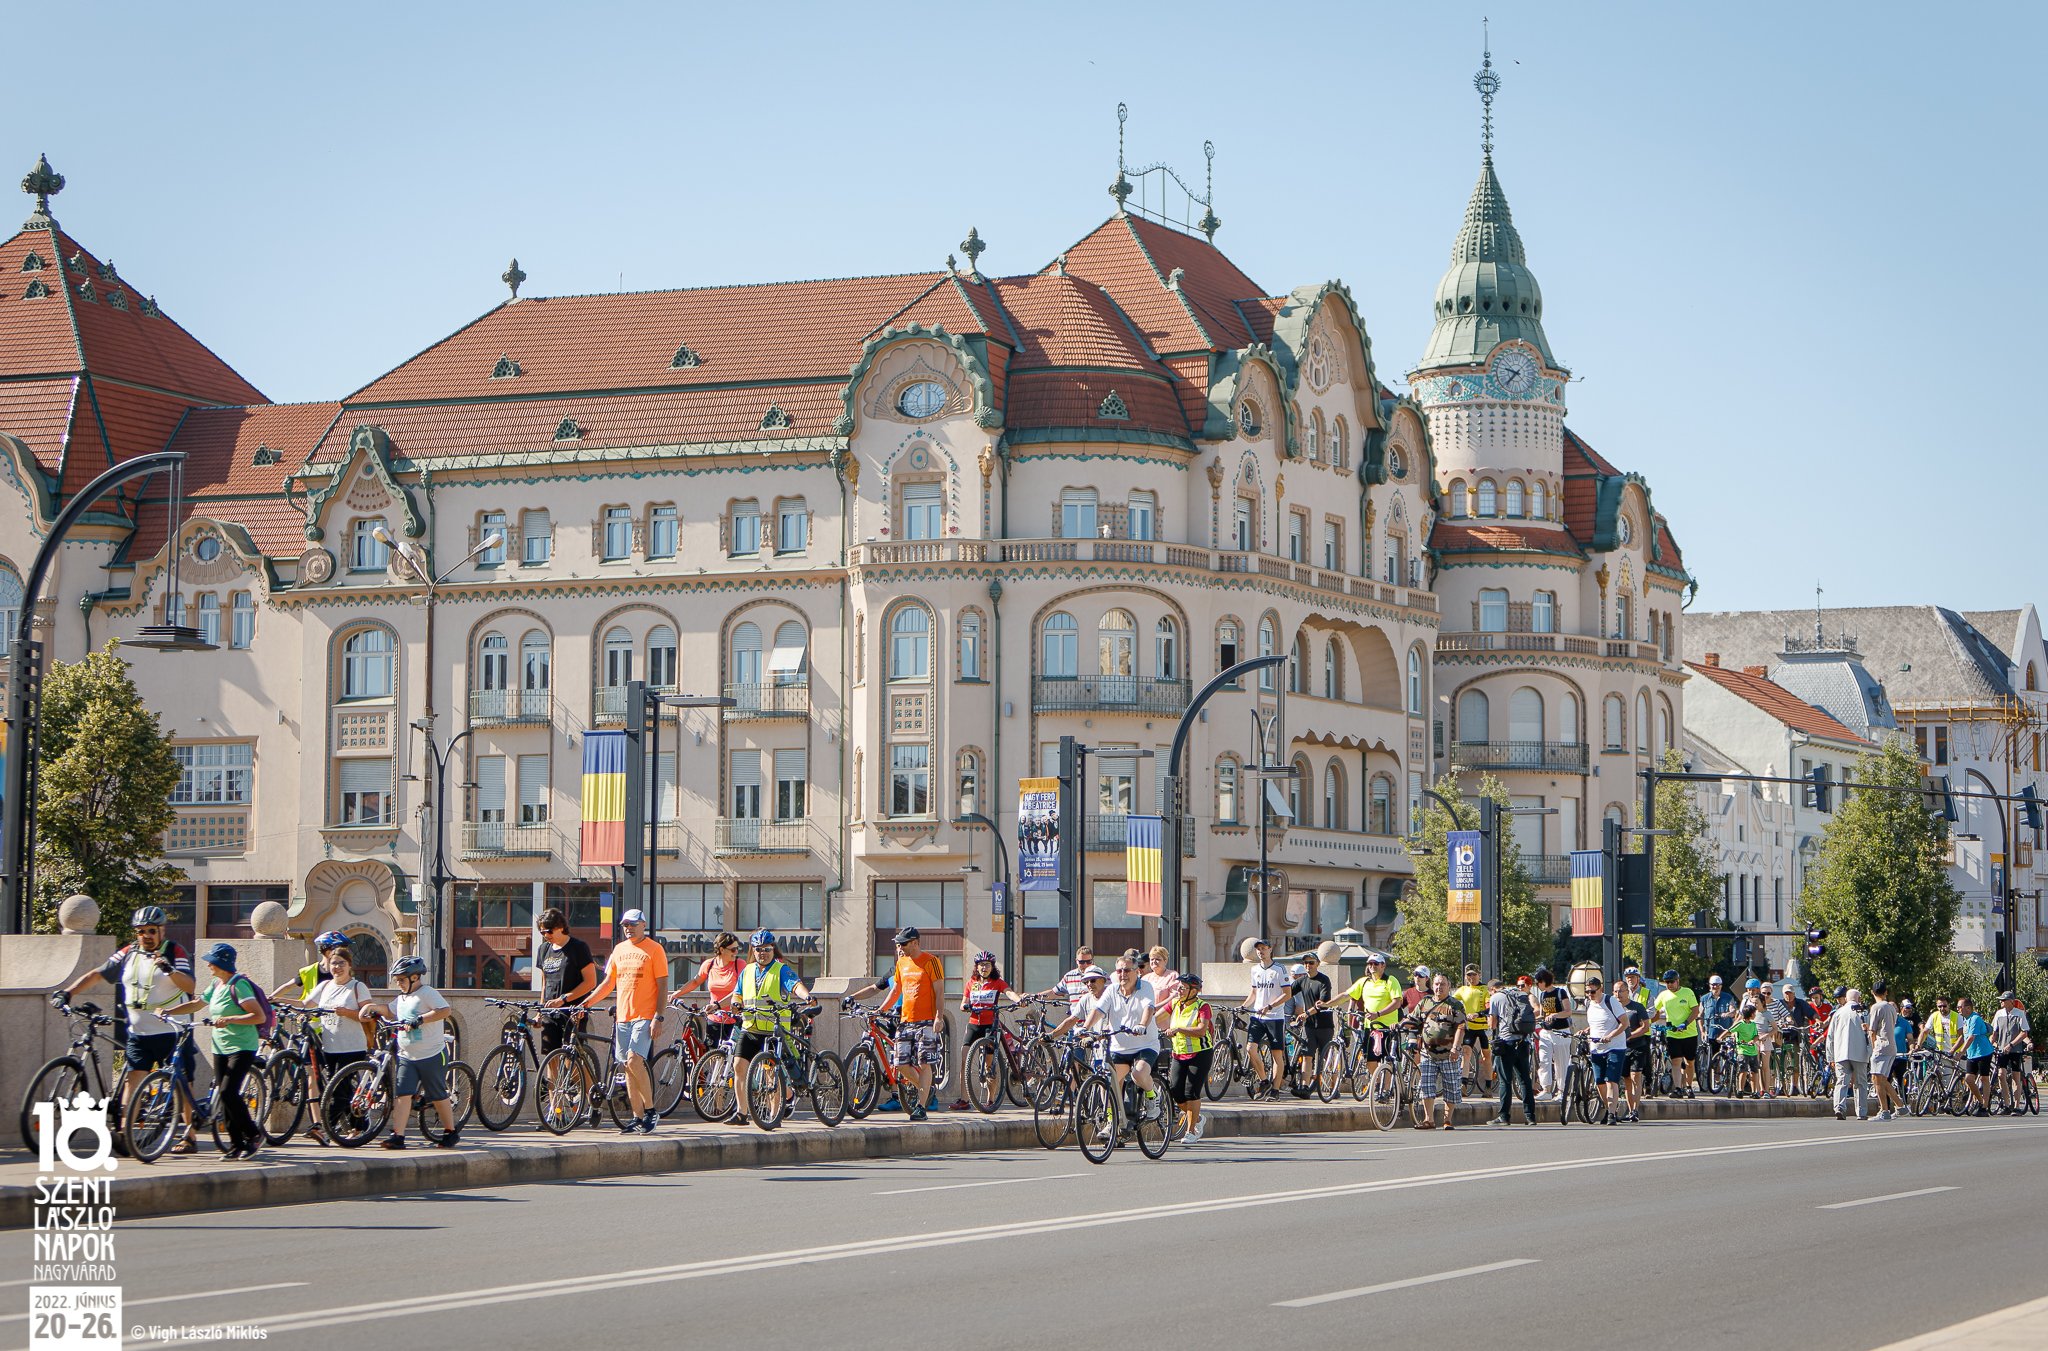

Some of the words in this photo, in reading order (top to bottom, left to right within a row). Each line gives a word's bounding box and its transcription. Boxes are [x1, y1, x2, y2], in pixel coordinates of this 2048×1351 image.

[654, 933, 752, 953] Raiffe
[775, 935, 820, 953] ANK
[1257, 980, 1275, 989] bwin
